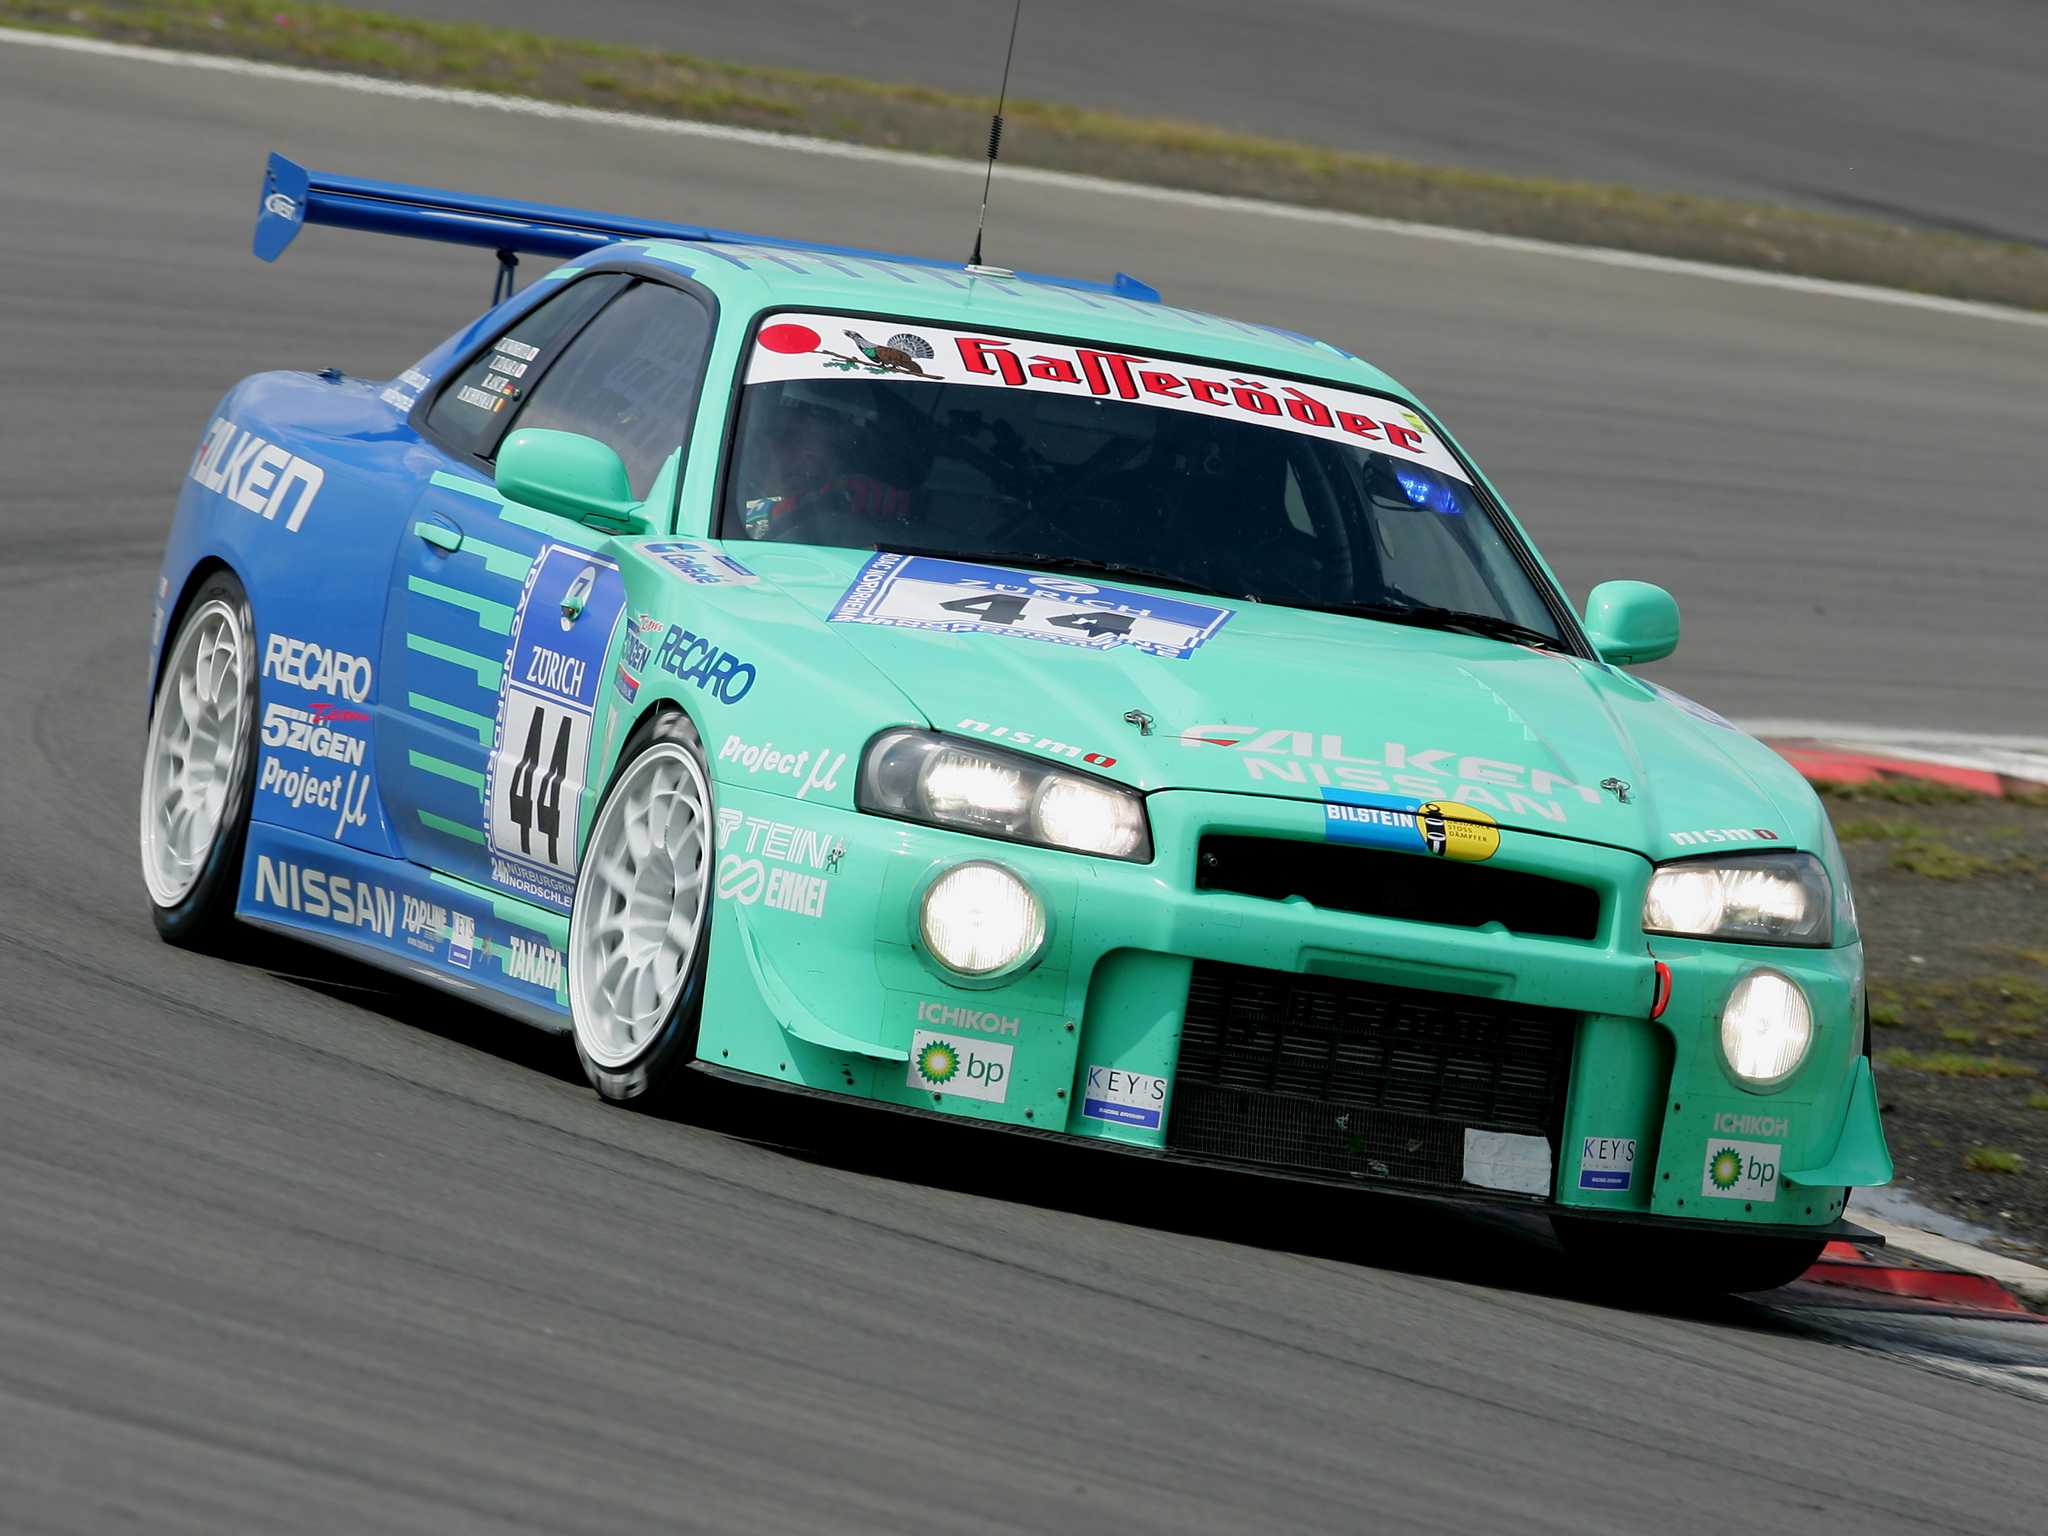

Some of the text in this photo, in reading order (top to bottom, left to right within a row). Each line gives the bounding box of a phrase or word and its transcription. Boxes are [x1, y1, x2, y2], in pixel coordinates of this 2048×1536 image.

[938, 593, 1138, 638] 44
[262, 633, 373, 704] RECARO
[653, 623, 757, 705] RECARO
[956, 718, 1118, 769] nismo
[509, 705, 573, 866] 44
[1242, 757, 1568, 824] NISSAN
[1326, 804, 1414, 829] BILSTEIN
[1669, 828, 1779, 846] nismo
[745, 816, 833, 870] TEIN
[255, 854, 395, 938] NISSAN
[764, 867, 828, 919] ENKEI
[508, 935, 562, 991] TAKATA
[917, 1001, 1020, 1038] ICHIKOH
[966, 1052, 1004, 1087] bp
[1713, 1112, 1788, 1138] ICHIKOH
[1747, 1156, 1775, 1183] bp
